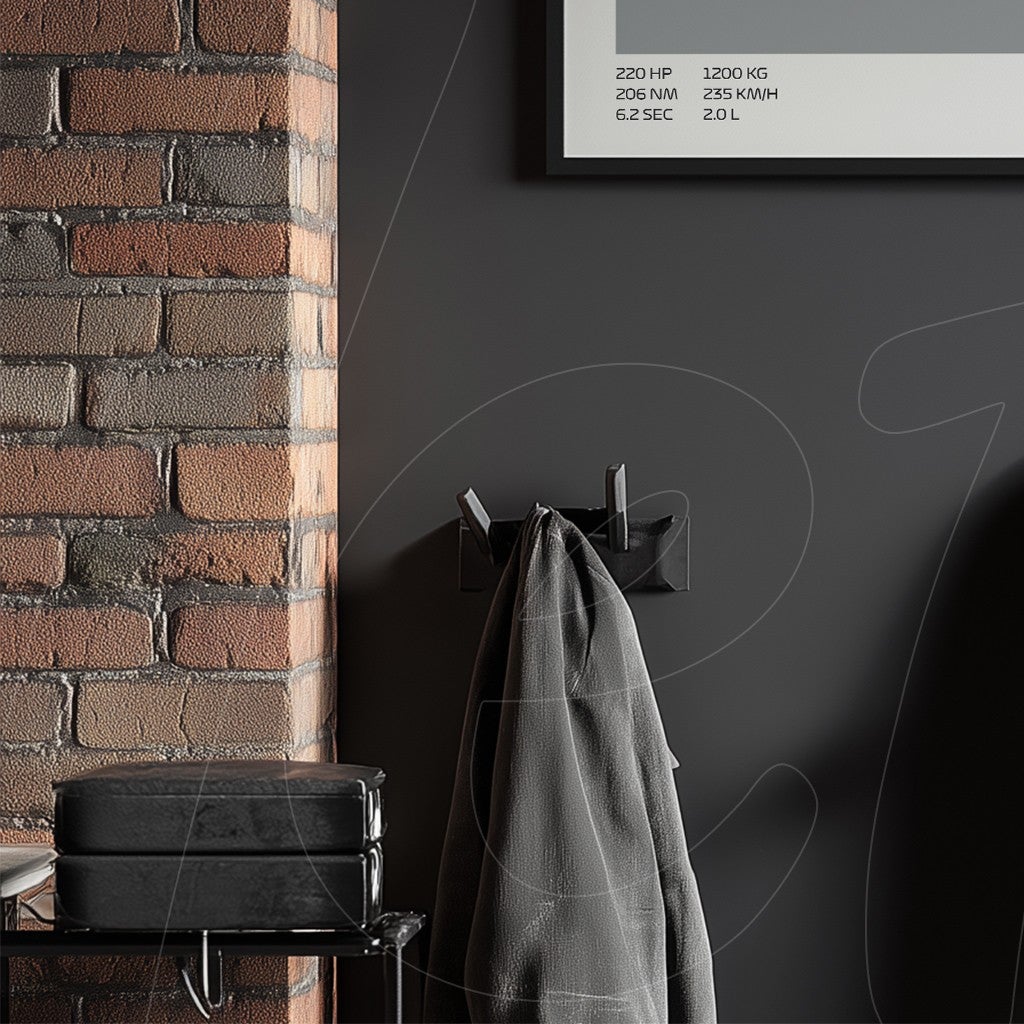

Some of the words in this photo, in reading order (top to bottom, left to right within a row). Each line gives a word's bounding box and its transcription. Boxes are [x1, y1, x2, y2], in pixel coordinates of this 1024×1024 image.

[615, 67, 647, 80] 220
[649, 67, 673, 80] HP
[703, 67, 743, 80] 1200
[746, 67, 768, 80] KG
[615, 87, 647, 101] 206
[649, 87, 679, 100] NM
[703, 87, 733, 100] 235
[736, 87, 778, 102] KM/H
[615, 108, 640, 121] 6.2
[642, 108, 674, 121] SEC
[703, 108, 727, 121] 2.0
[730, 108, 740, 121] L
